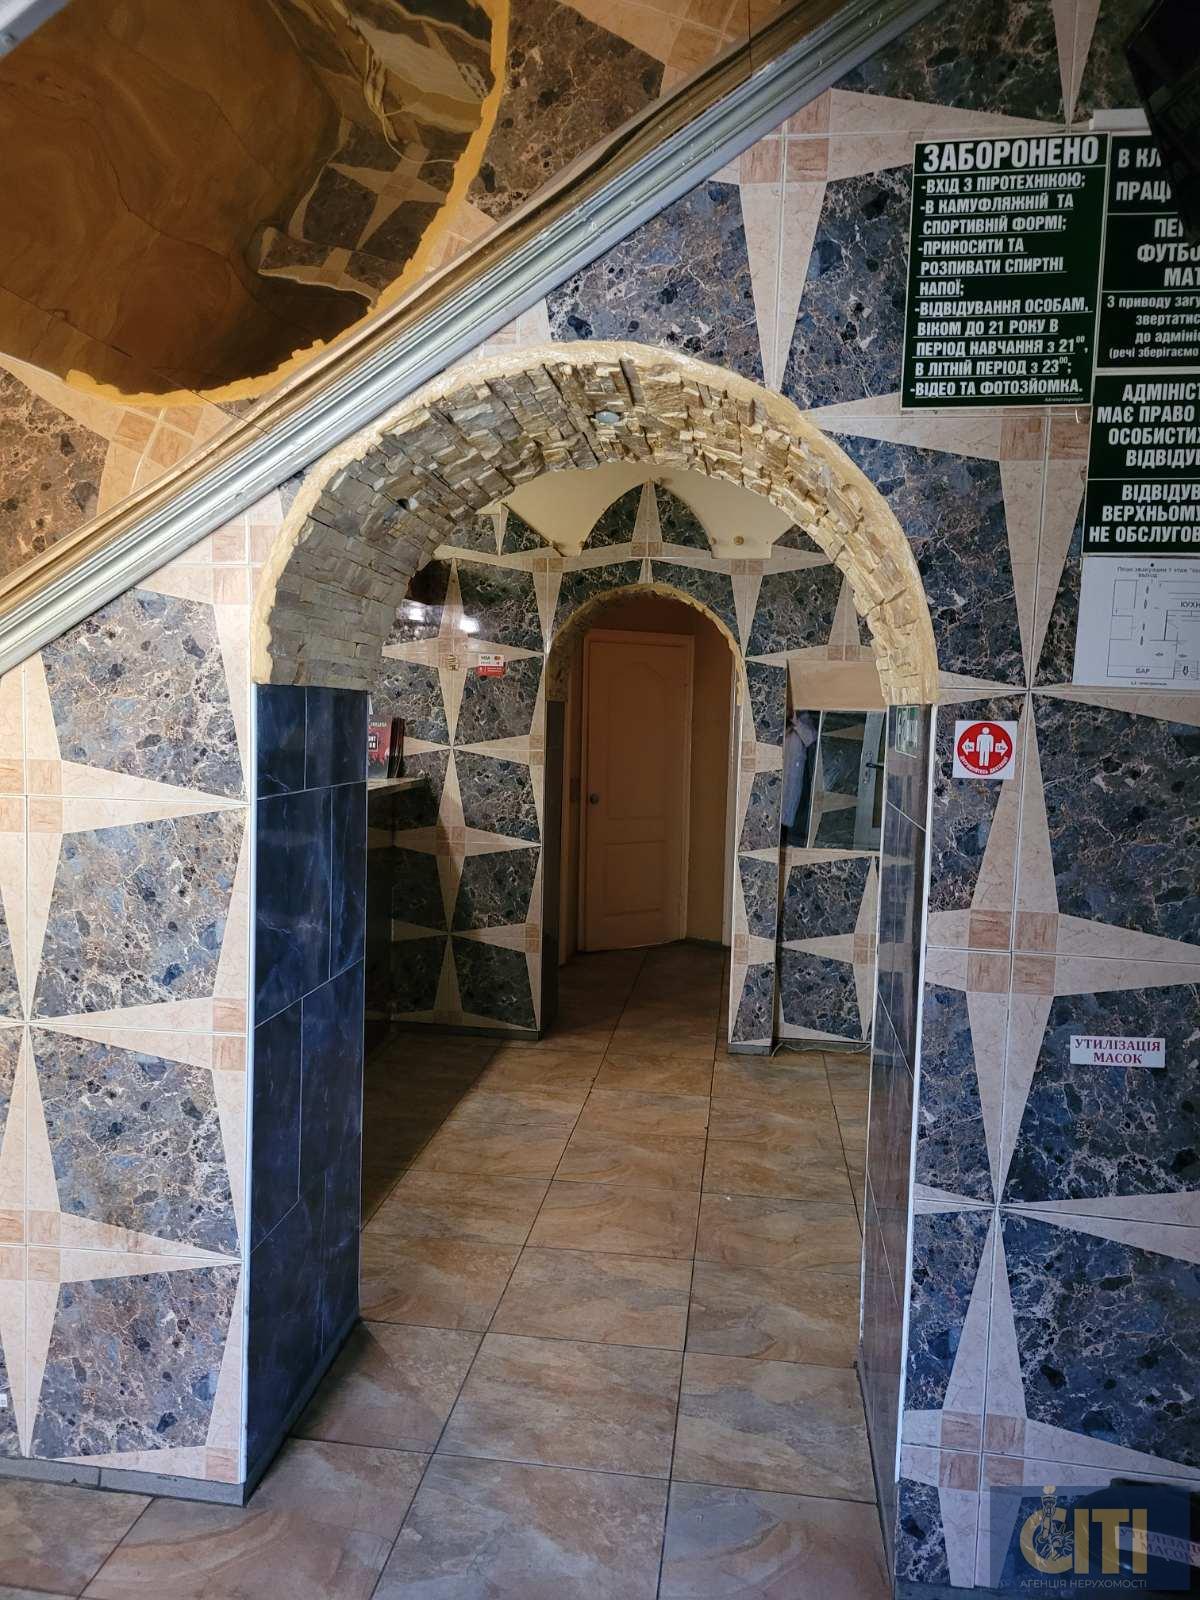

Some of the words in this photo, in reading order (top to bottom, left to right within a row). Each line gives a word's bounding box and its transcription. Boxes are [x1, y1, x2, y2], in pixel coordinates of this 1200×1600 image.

[923, 136, 1099, 172] ЗАБОРОНЕНО
[1118, 148, 1130, 168] В
[921, 178, 960, 194] -ВХІД
[963, 179, 972, 191] З
[977, 172, 1086, 191] ПІРОТЕХНІКОЮ;
[938, 192, 1049, 213] КАМУФЛЯЖНІЙ
[1057, 193, 1074, 209] ТА
[923, 215, 1008, 235] СПОРТИВНІЙ
[1012, 215, 1067, 231] ФОРМІ;
[918, 239, 1004, 255] -ПРИНОСИТИ
[1008, 237, 1024, 253] ТА
[921, 259, 1000, 276] РОЗПИВАТИ
[1005, 256, 1064, 273] СПИРТНІ
[919, 279, 964, 296] НАПОЇ;
[915, 300, 1021, 317] -ВІДВІДУВАННЯ
[1107, 295, 1115, 308] З
[1118, 296, 1172, 309] приводу
[917, 321, 961, 336] ВІКОМ
[965, 321, 984, 337] ДО
[988, 320, 1004, 334] 21
[1009, 319, 1045, 334] РОКУ
[1050, 319, 1059, 333] В
[1135, 332, 1151, 345] до
[916, 341, 966, 357] ПЕРІОД
[970, 339, 1043, 355] НАВЧАННЯ
[1109, 347, 1135, 359] (речі
[1138, 346, 1199, 358] зберігаємо
[915, 362, 924, 376] В
[928, 360, 972, 375] ЛІТНІЙ
[976, 360, 1027, 375] ПЕРІОД
[910, 381, 955, 397] -ВІДЕО
[960, 381, 976, 395] ТА
[980, 378, 1083, 394] ФОТОЗЙОМКА.
[1096, 406, 1134, 423] МАЄ
[1139, 405, 1195, 423] ПРАВО
[1122, 484, 1200, 503] ВІДВІДУВ
[1089, 526, 1110, 542] НЕ
[1115, 525, 1200, 543] ОБСЛУГОВ
[1075, 1039, 1160, 1053] УТИЛІЗАЦІЯ
[1093, 1052, 1142, 1064] МАСОК
